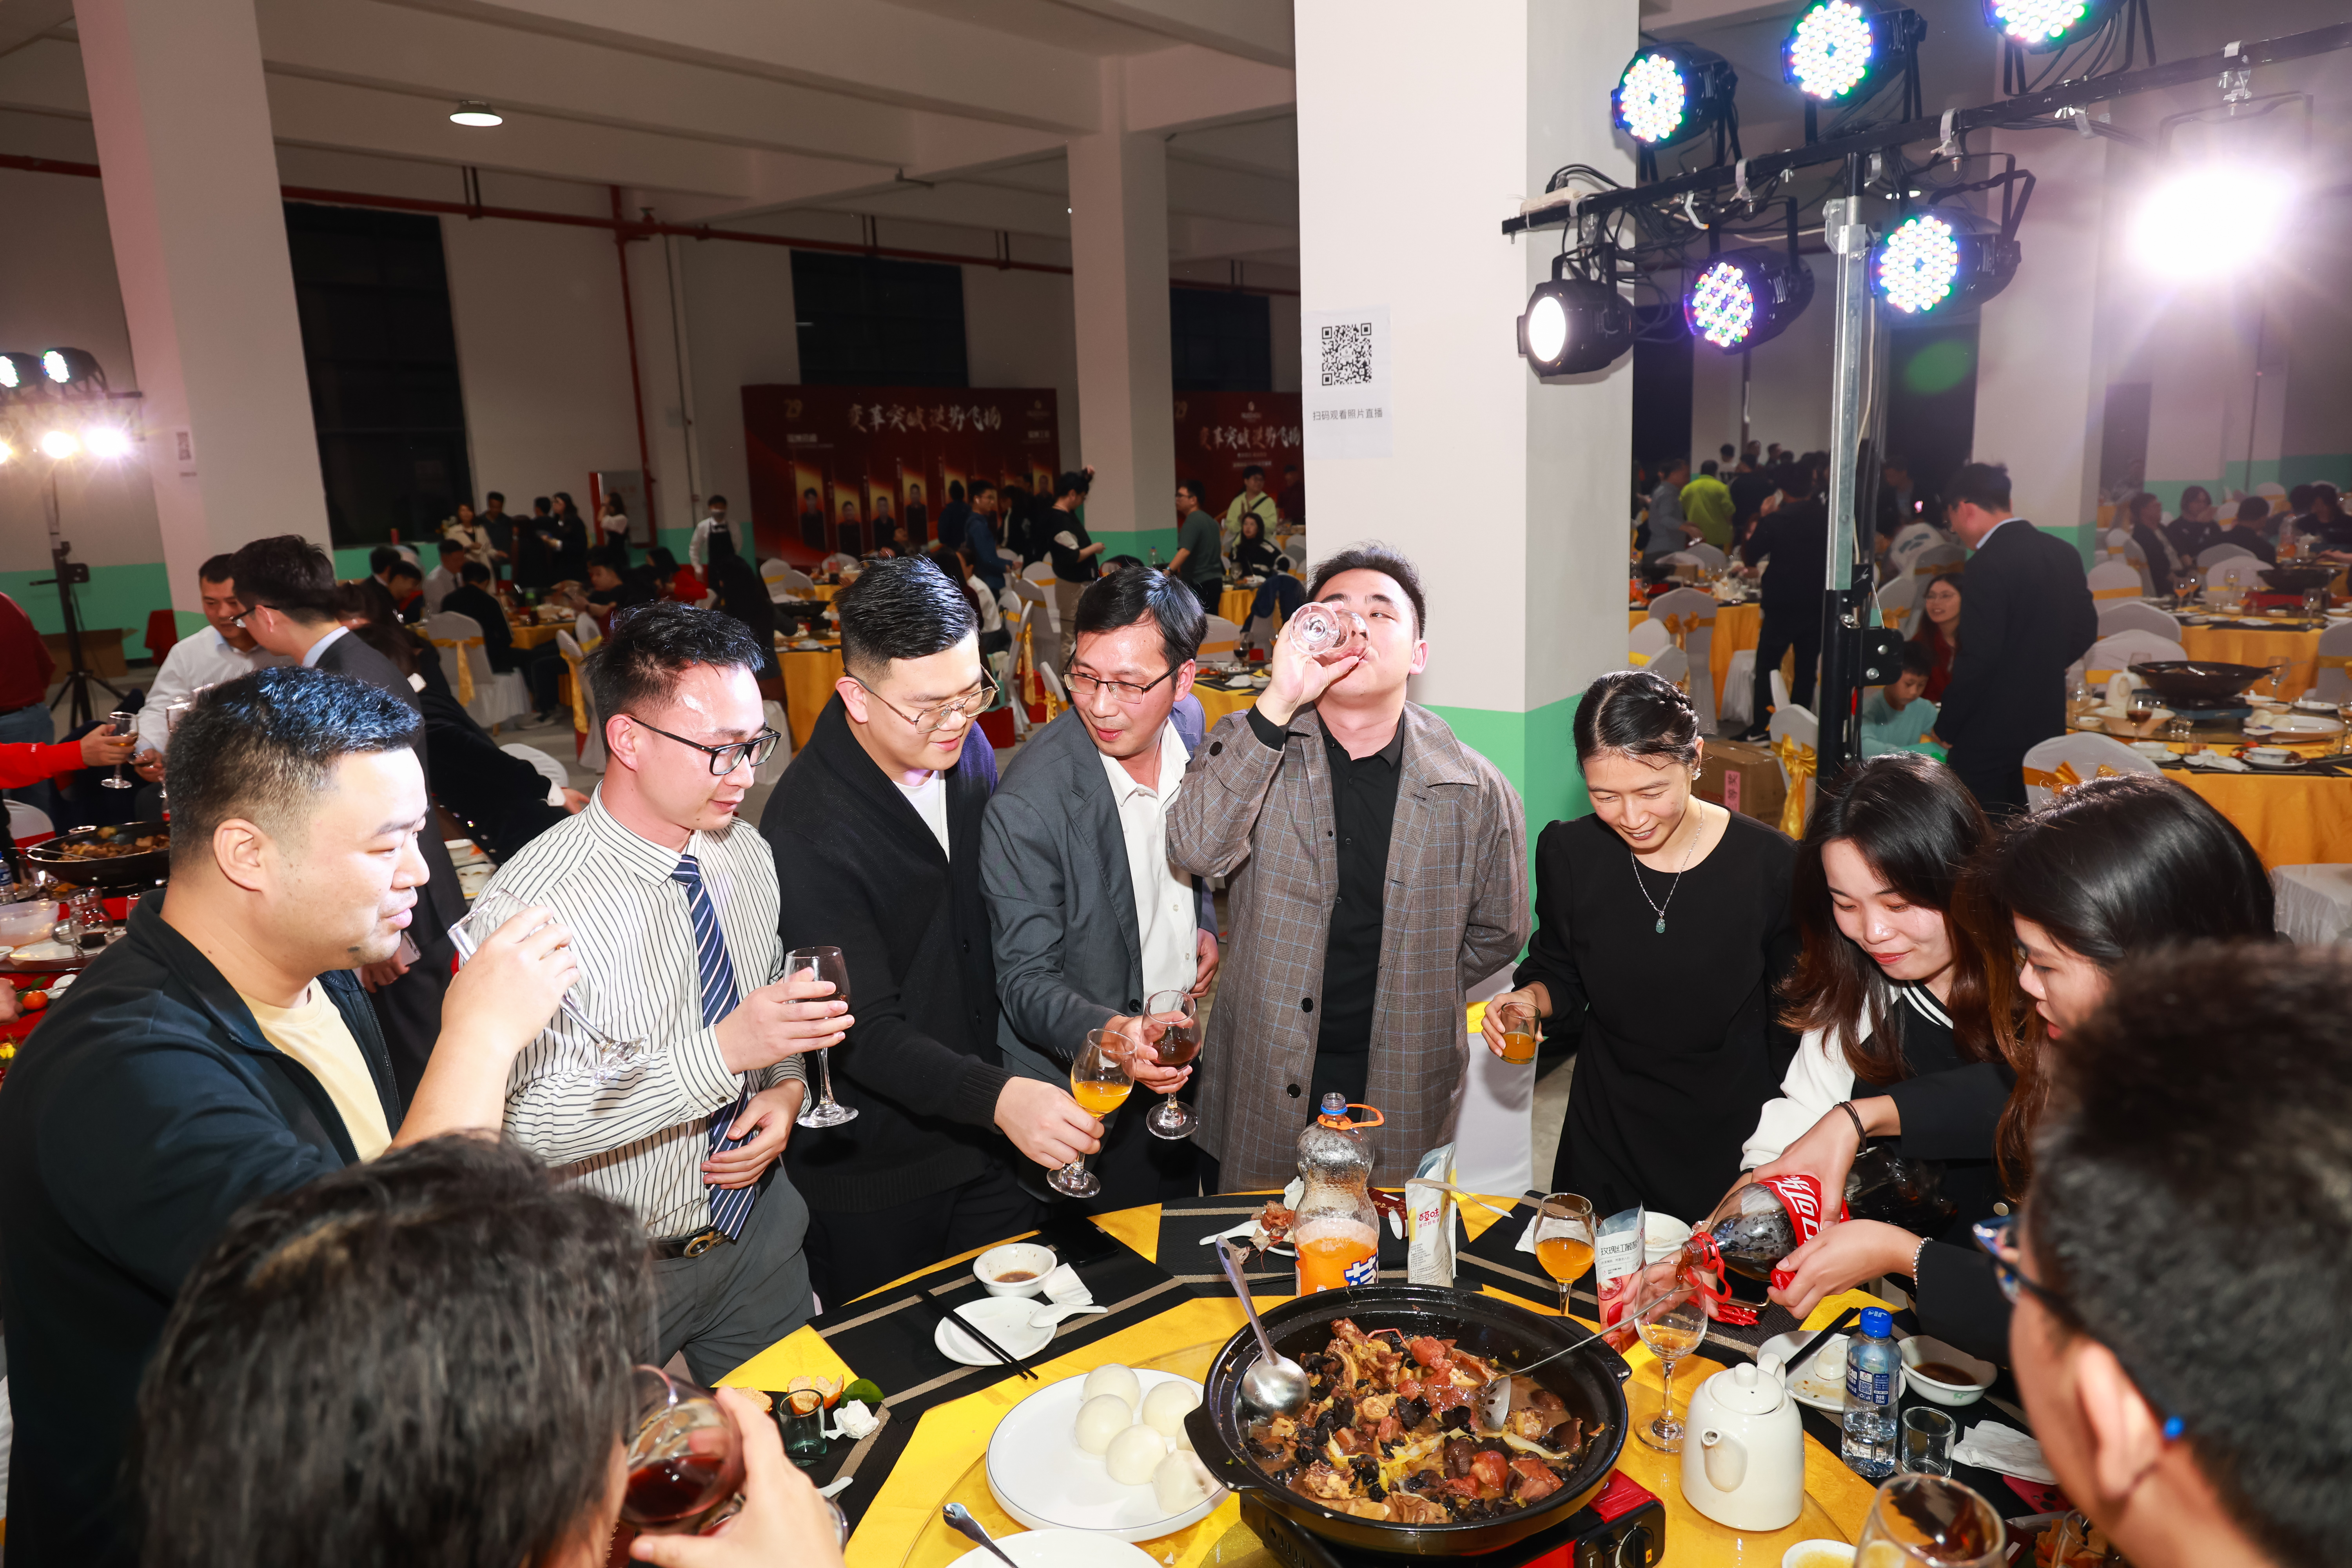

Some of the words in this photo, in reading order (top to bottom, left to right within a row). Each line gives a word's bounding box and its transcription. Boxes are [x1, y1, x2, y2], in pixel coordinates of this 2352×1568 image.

[1312, 408, 1383, 421] 扫码观看照片直播
[1419, 1207, 1439, 1221] 百草味
[1764, 1175, 1820, 1243] 口可乐
